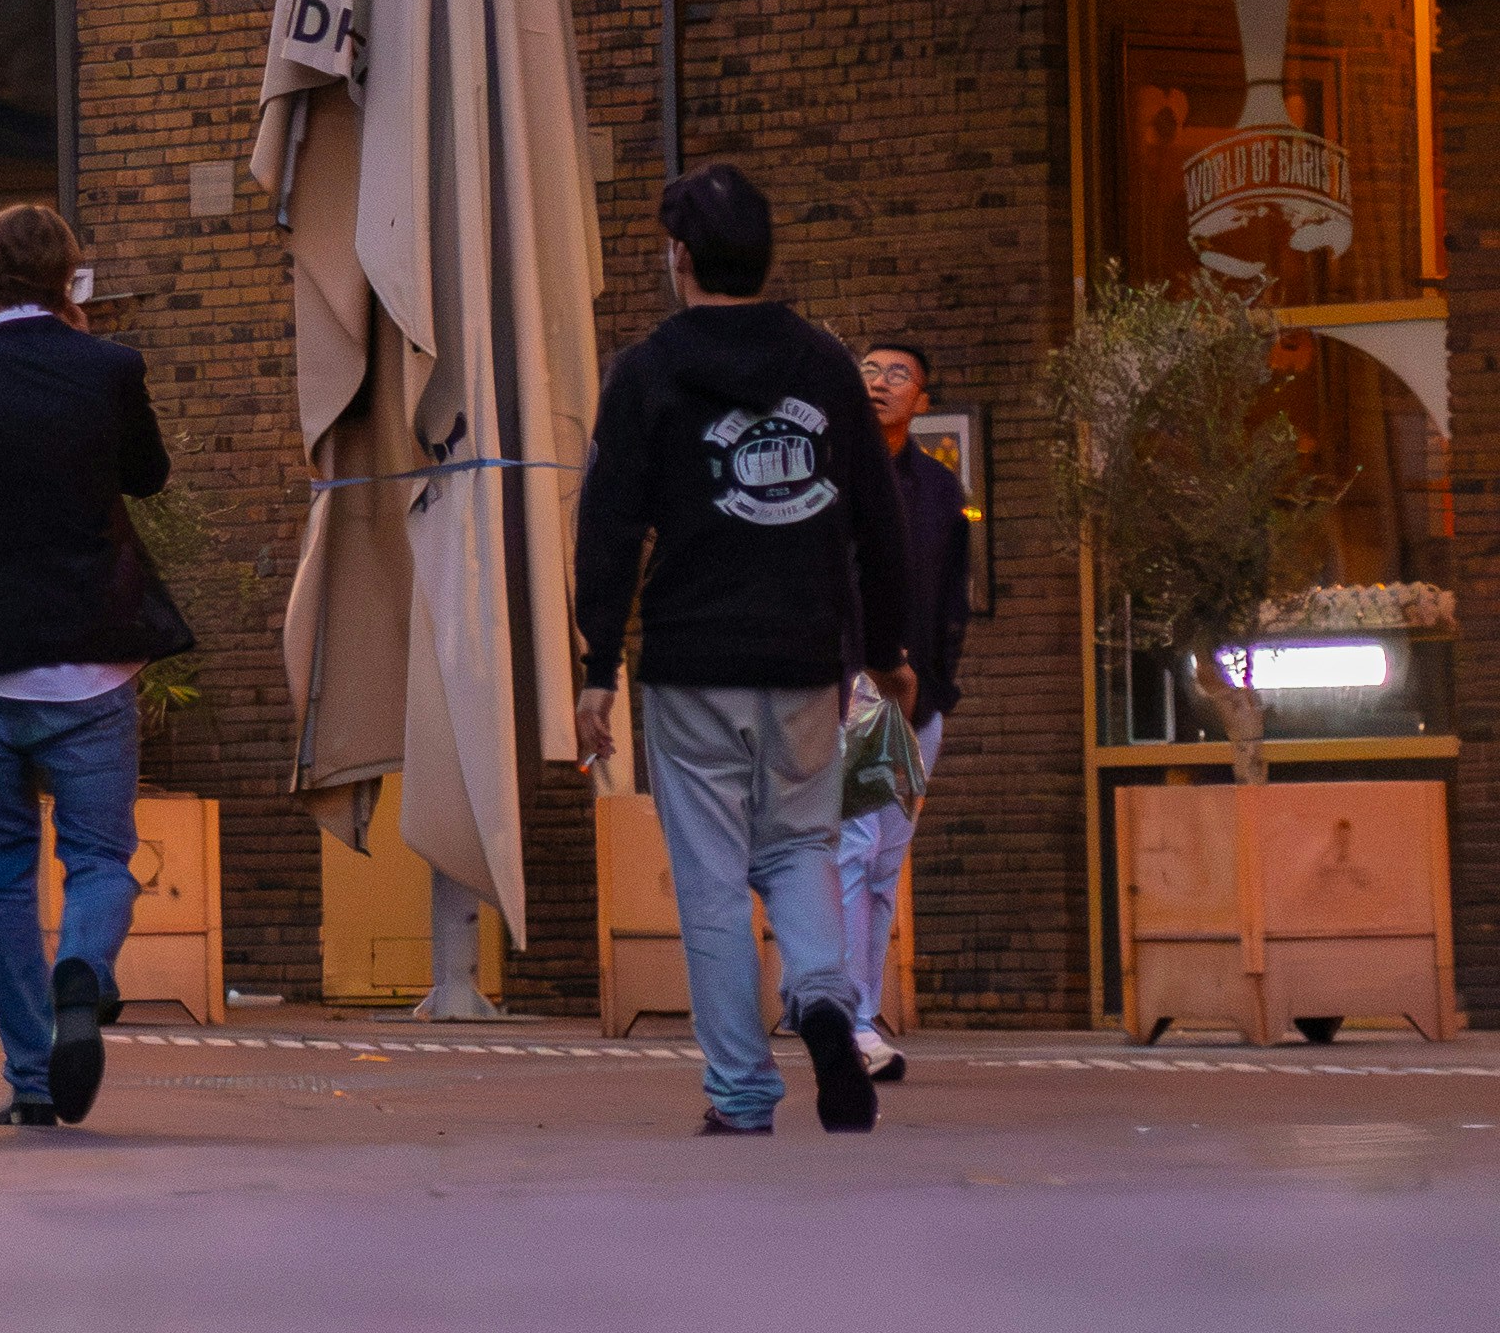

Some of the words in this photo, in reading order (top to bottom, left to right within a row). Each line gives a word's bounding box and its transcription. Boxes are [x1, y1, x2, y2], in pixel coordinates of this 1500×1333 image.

[1183, 144, 1248, 213] WORLD
[1250, 139, 1275, 185] OF
[1278, 139, 1352, 205] BARISTA
